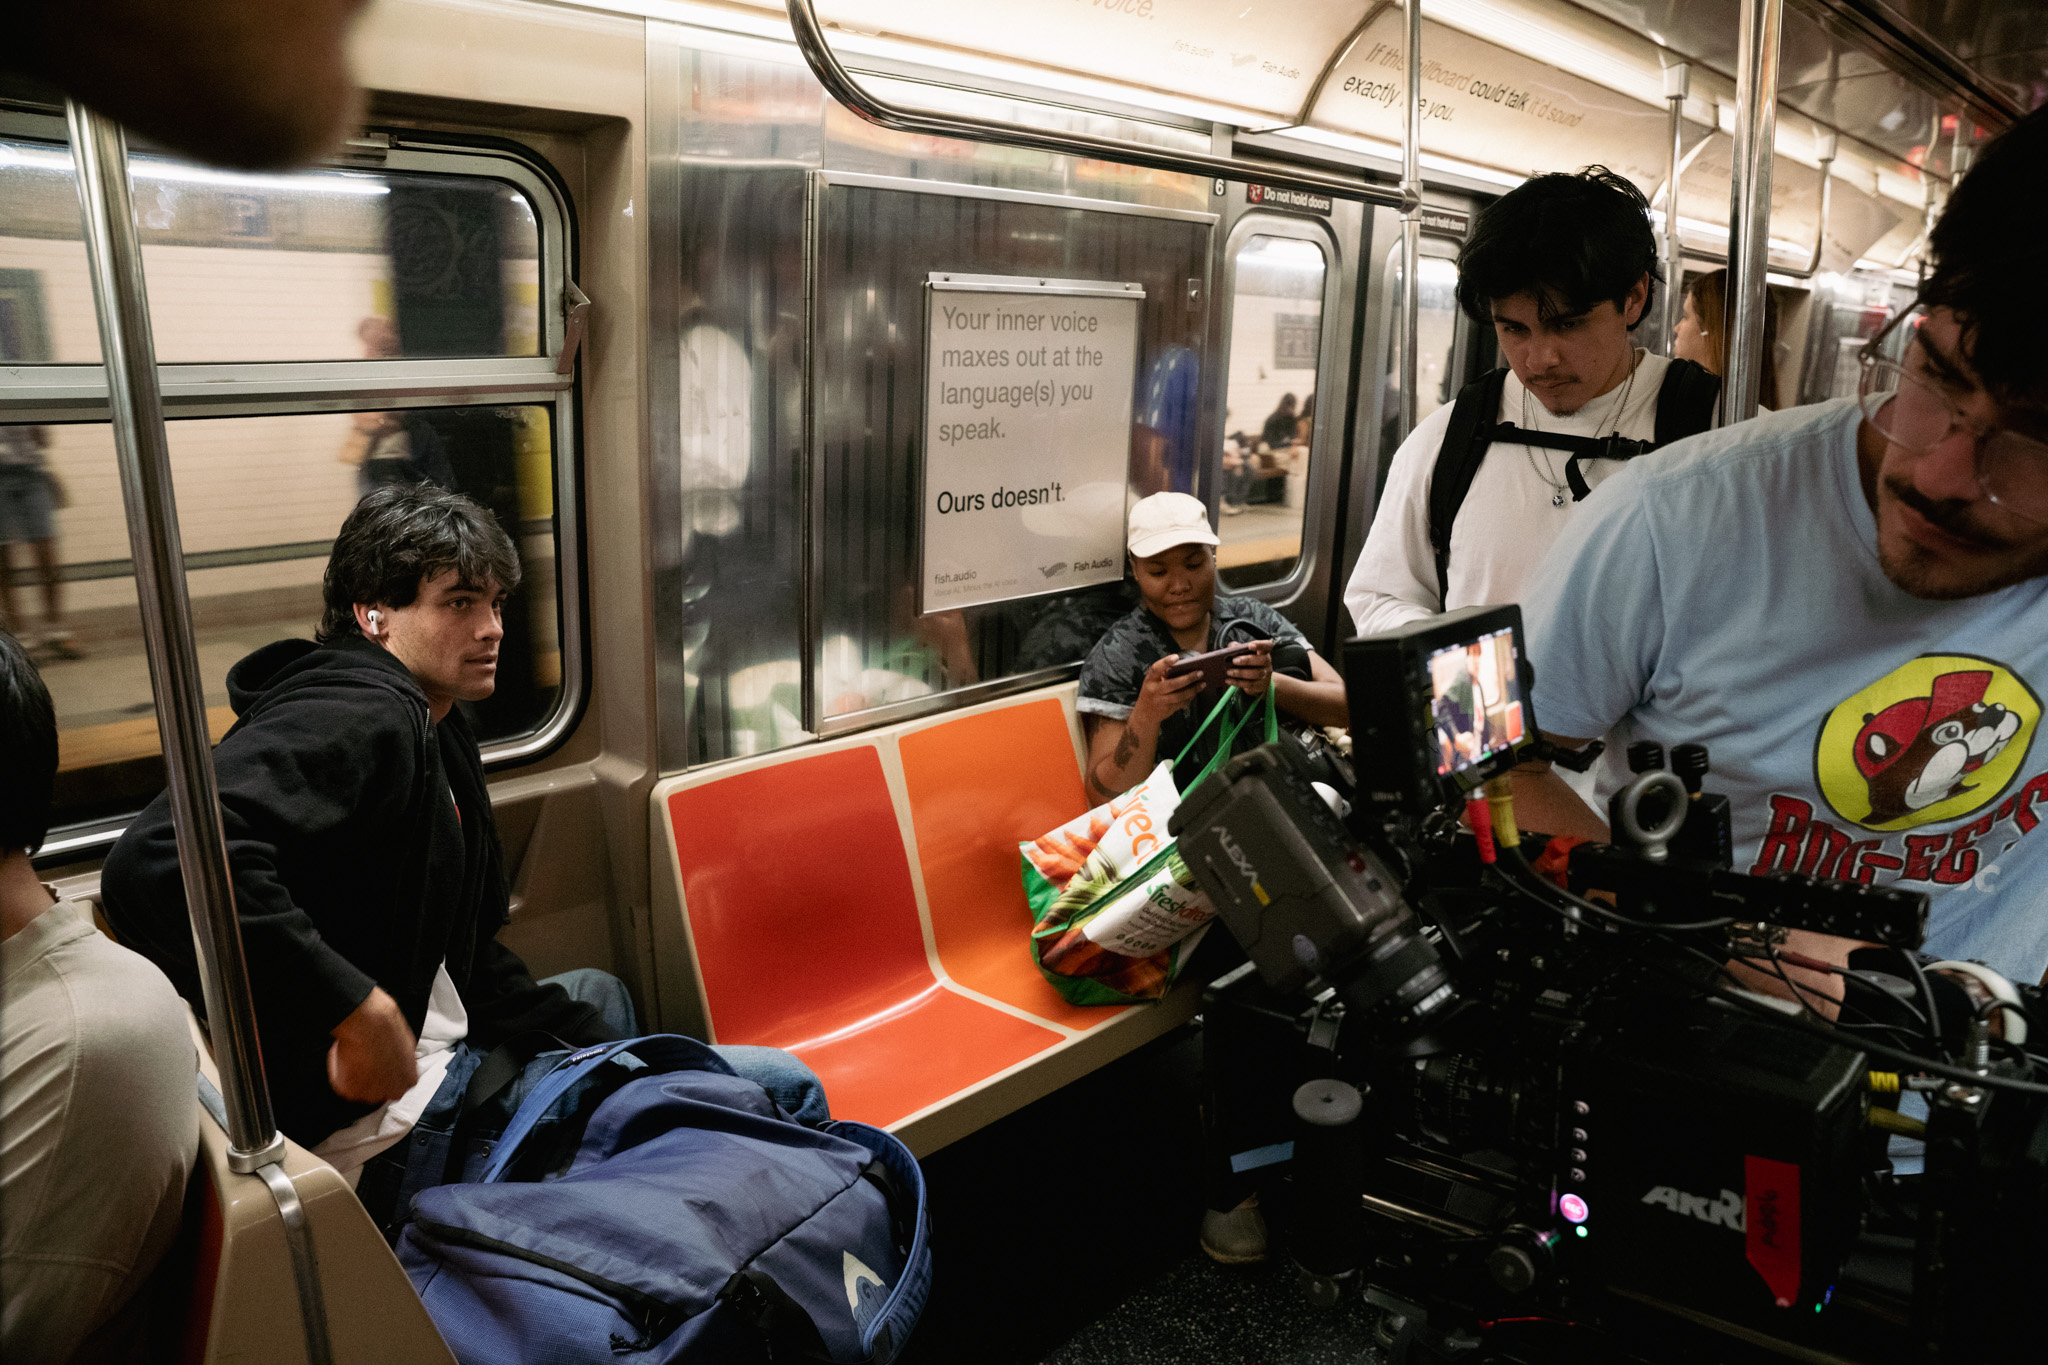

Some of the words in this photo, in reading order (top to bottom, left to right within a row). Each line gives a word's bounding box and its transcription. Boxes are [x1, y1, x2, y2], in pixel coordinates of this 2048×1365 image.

[1260, 61, 1278, 74] Fish
[1278, 65, 1300, 80] Audio
[1365, 42, 1381, 62] If
[1419, 54, 1474, 91] illboard
[1469, 78, 1507, 103] could
[1504, 86, 1530, 112] talk
[1548, 106, 1586, 128] sound
[1343, 76, 1400, 109] exactly
[1424, 103, 1453, 122] you.
[1215, 179, 1224, 196] 6
[1263, 187, 1276, 201] Do
[1276, 191, 1290, 204] not
[1290, 191, 1308, 206] hold
[1308, 196, 1330, 210] doors
[1426, 216, 1437, 227] not
[1437, 216, 1450, 229] hold
[1450, 219, 1466, 231] doors
[942, 306, 990, 331] Your
[996, 308, 1045, 332] inner
[1050, 311, 1098, 332] voice
[942, 349, 1009, 368] maxes
[1016, 346, 1046, 367] out
[1052, 347, 1070, 367] at
[1076, 345, 1103, 367] the
[940, 380, 1055, 409] language(s)
[1061, 383, 1093, 405] you
[939, 417, 1006, 446] speak.
[937, 490, 985, 514] Ours
[991, 482, 1066, 510] doesn't.
[935, 569, 977, 585] fish.audio
[1073, 561, 1089, 572] Fish
[1091, 558, 1113, 570] Audio
[1210, 826, 1258, 888] ALEXA
